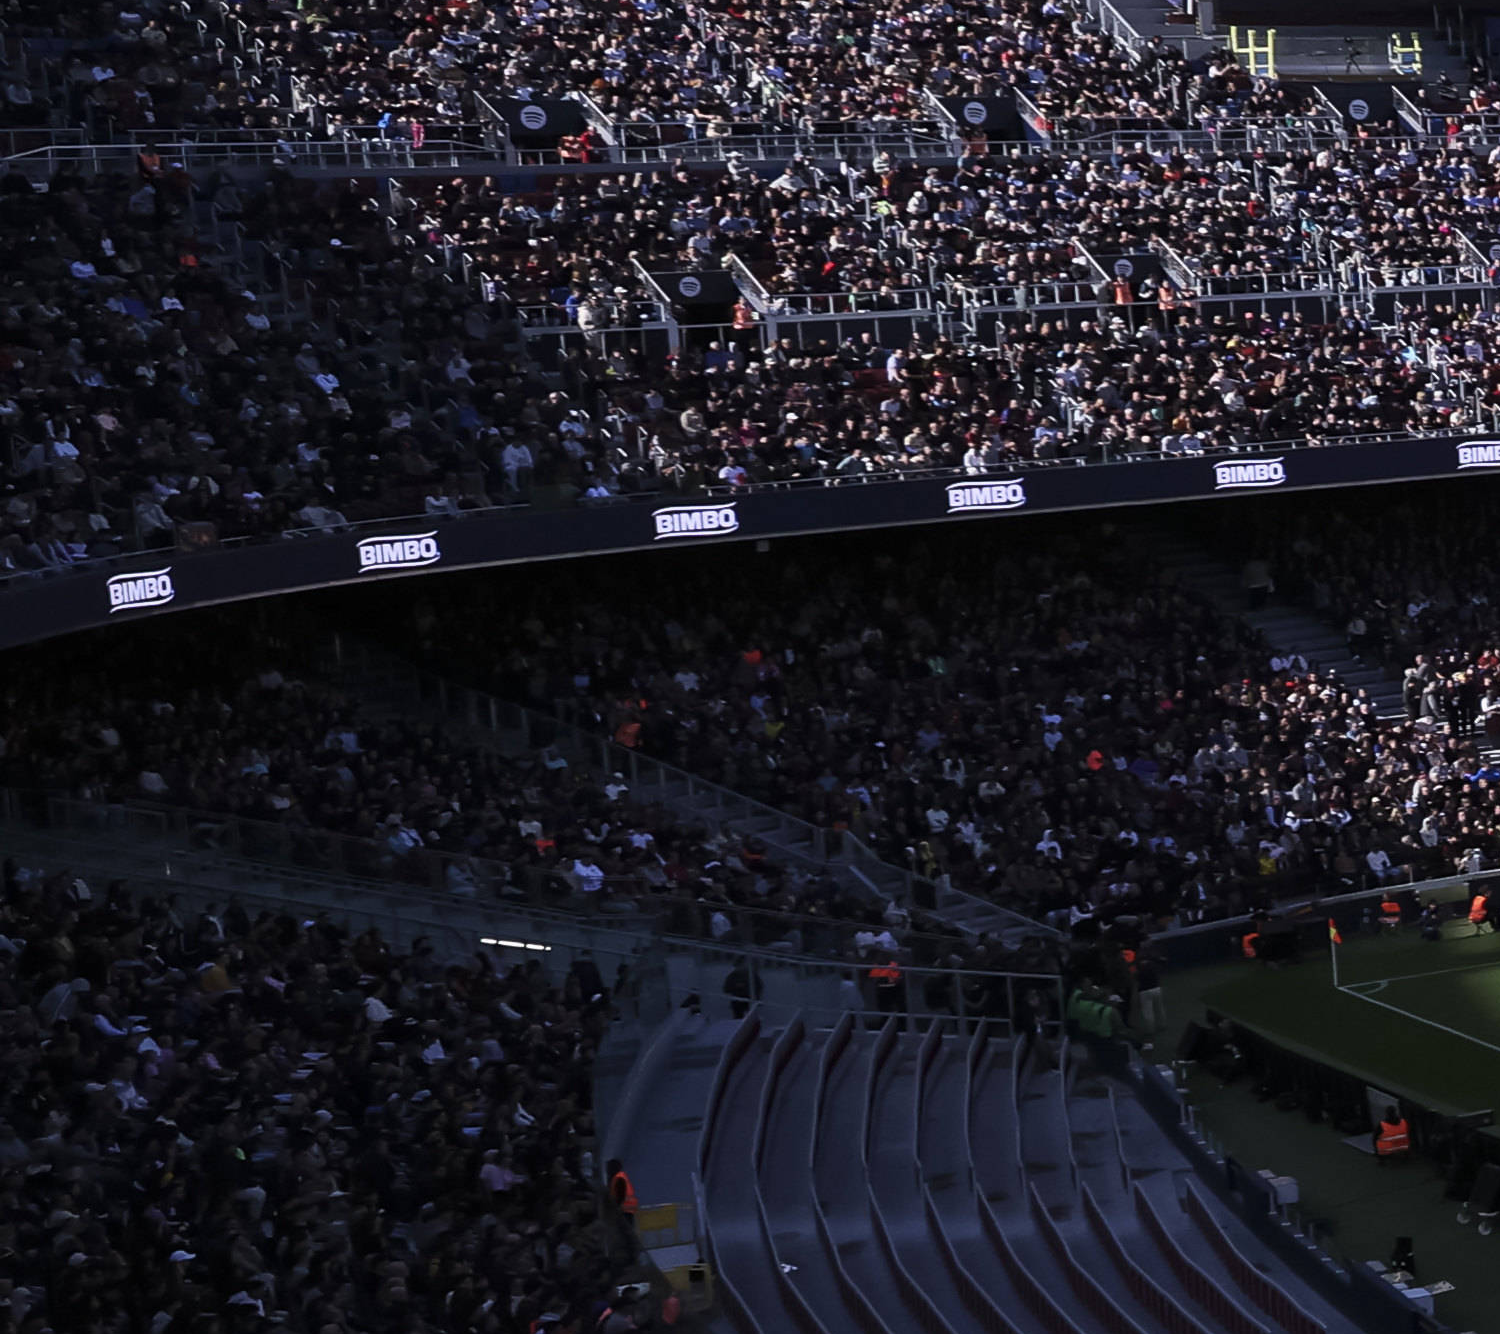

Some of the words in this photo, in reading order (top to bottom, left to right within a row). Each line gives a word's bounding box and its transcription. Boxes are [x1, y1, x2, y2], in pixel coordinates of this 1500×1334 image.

[1216, 463, 1283, 483] BIMBO
[948, 485, 1023, 508] BIMBO
[656, 510, 736, 533] BIMBO
[360, 539, 438, 565] BIMBO
[109, 576, 171, 605] BIMBO
